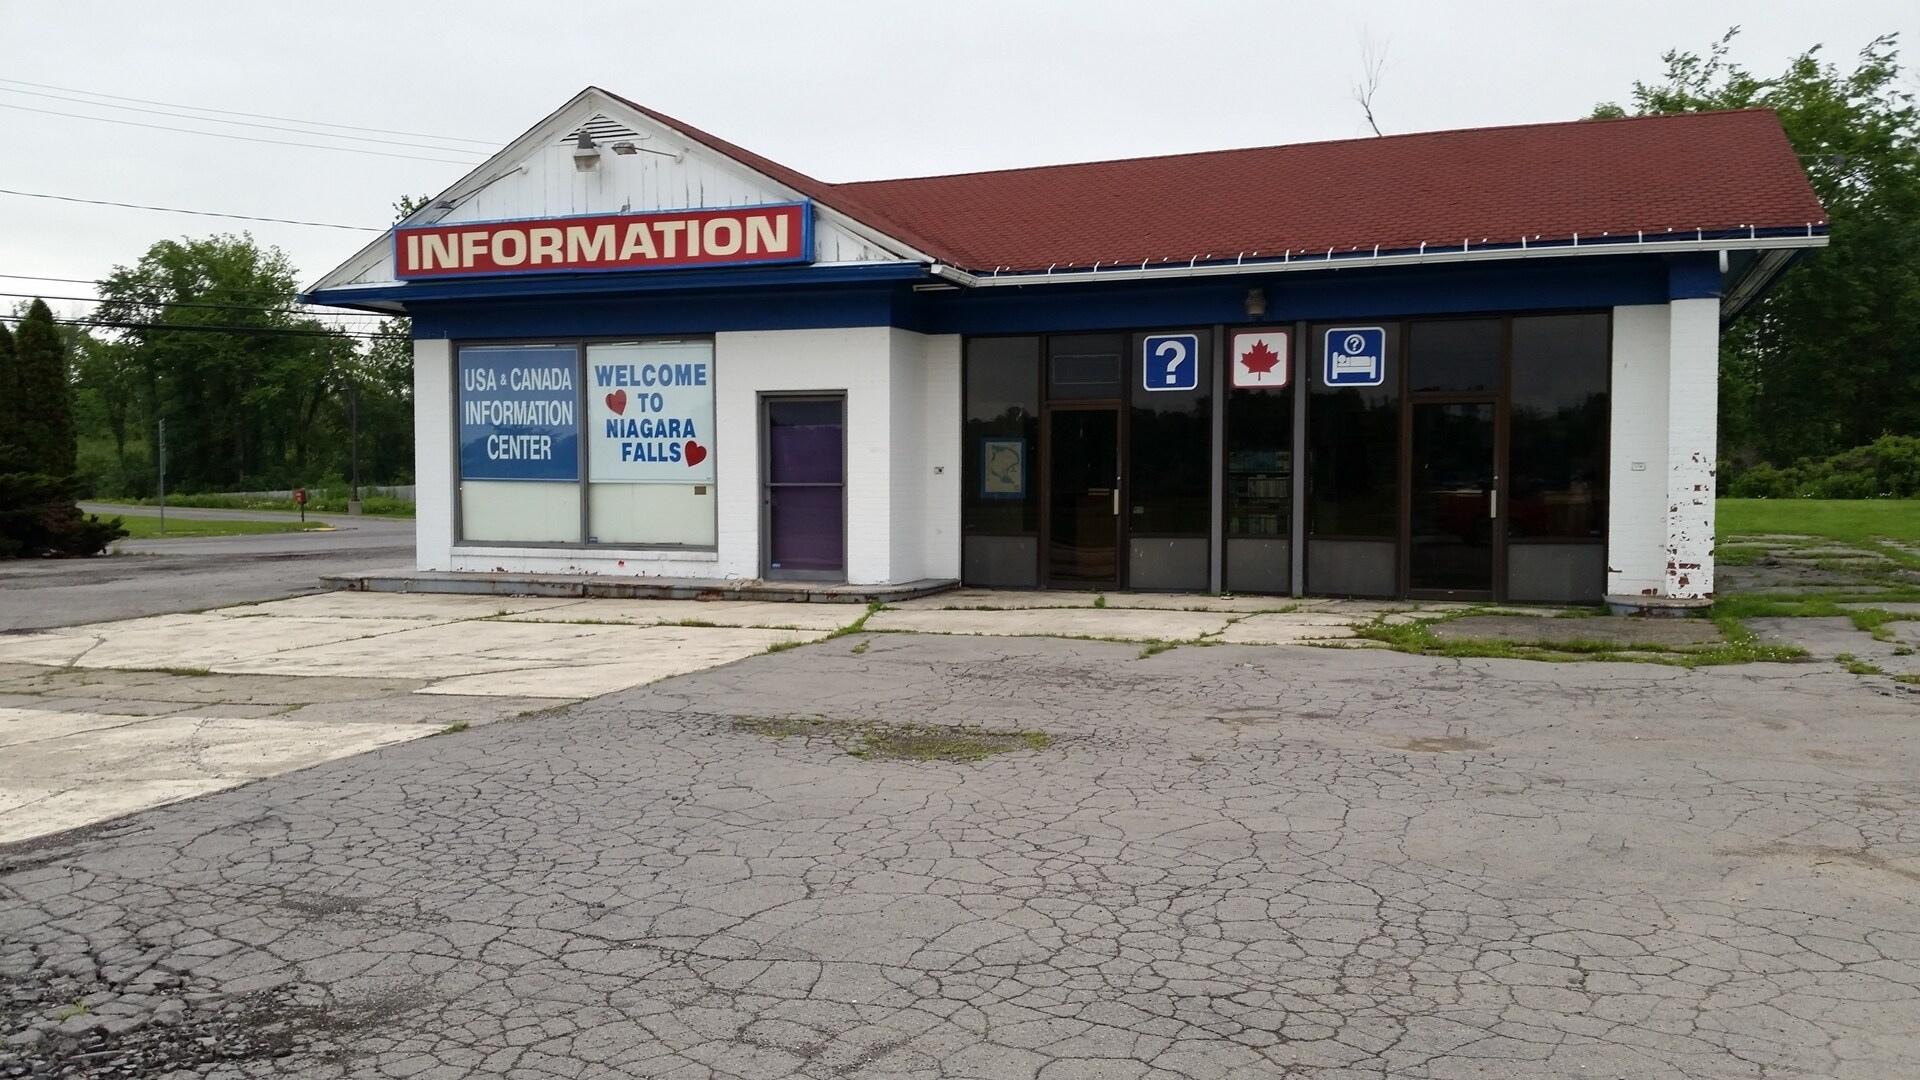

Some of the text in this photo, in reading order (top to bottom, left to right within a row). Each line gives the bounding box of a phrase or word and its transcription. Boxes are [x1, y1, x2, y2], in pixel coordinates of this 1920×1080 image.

[407, 214, 789, 270] INFORMATION
[1155, 340, 1187, 384] ?
[464, 367, 572, 391] USA & CANADA
[595, 364, 707, 387] WELCOME
[465, 400, 573, 425] INFORMATION
[637, 392, 664, 412] TO
[606, 418, 696, 438] NIAGARA
[487, 434, 552, 460] CENTER
[622, 442, 682, 462] FALLS
